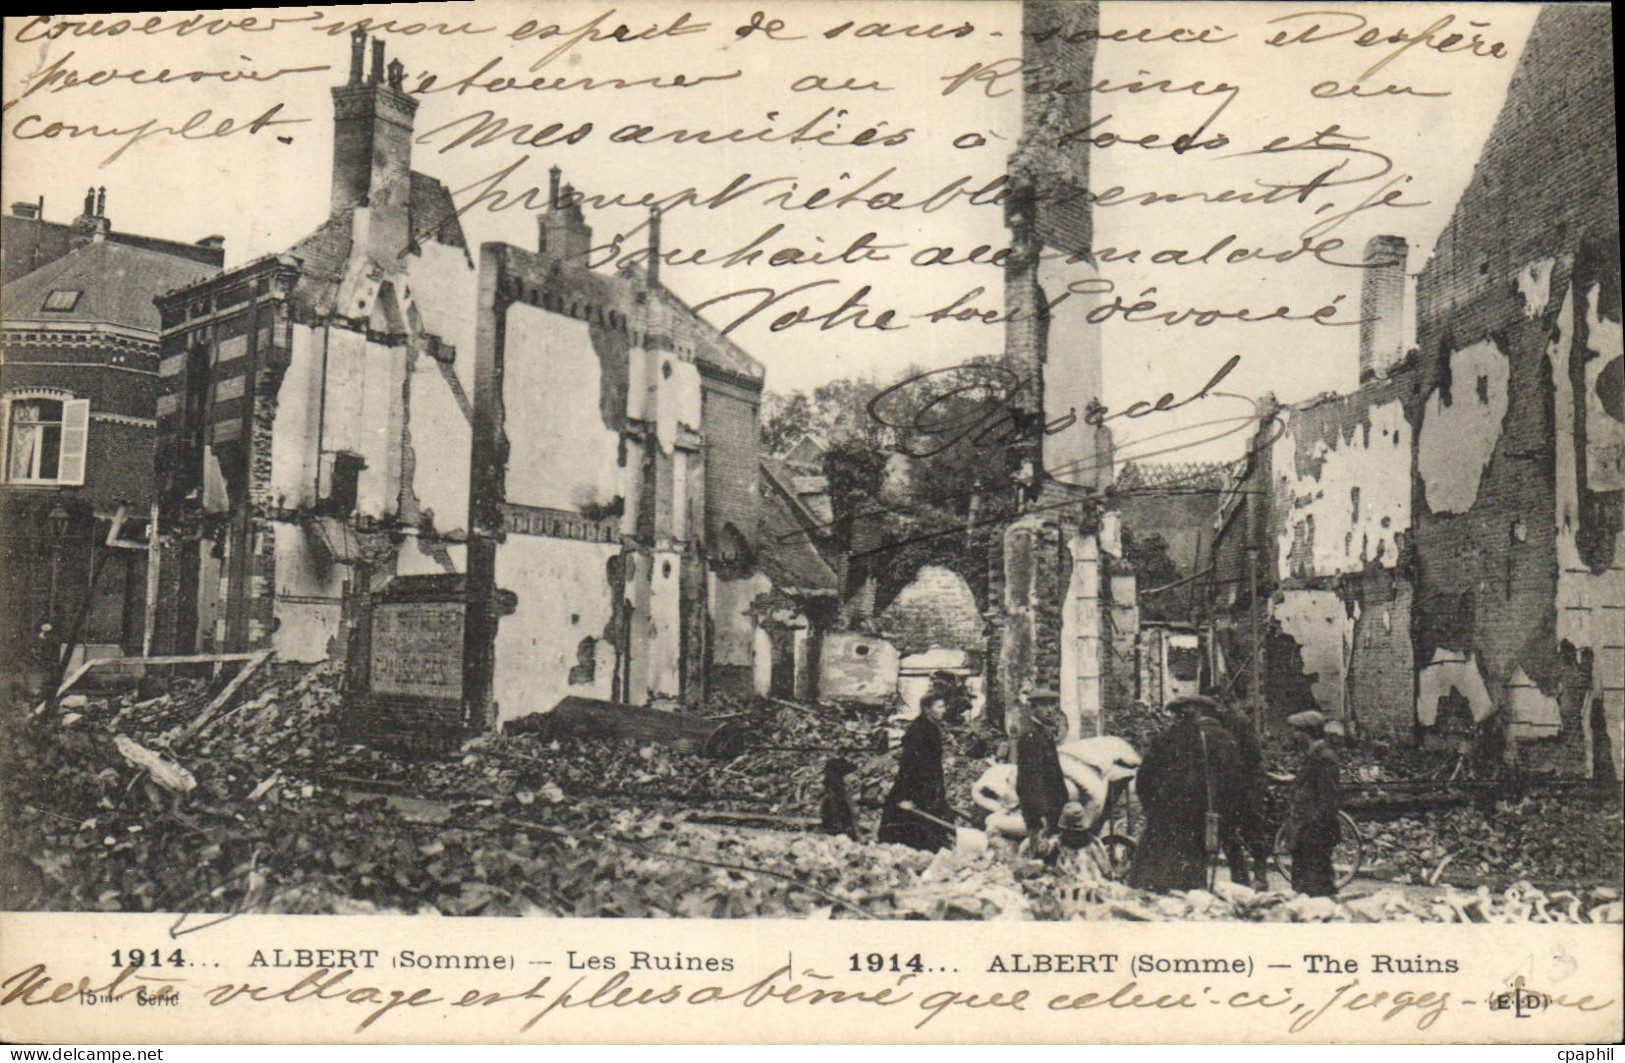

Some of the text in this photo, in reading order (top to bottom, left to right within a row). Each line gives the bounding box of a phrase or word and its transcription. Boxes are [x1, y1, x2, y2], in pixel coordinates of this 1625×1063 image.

[735, 11, 806, 40] de
[415, 110, 591, 154] Mes
[110, 948, 220, 968] 1914...
[249, 949, 380, 968] ALBERT
[568, 951, 616, 970] Les
[630, 951, 735, 971] Ruines
[848, 952, 959, 973] 1914...
[986, 954, 1118, 973] ALBERT
[1130, 953, 1254, 975] (Somme)
[1303, 955, 1358, 974] The
[1371, 955, 1460, 974] Ruins
